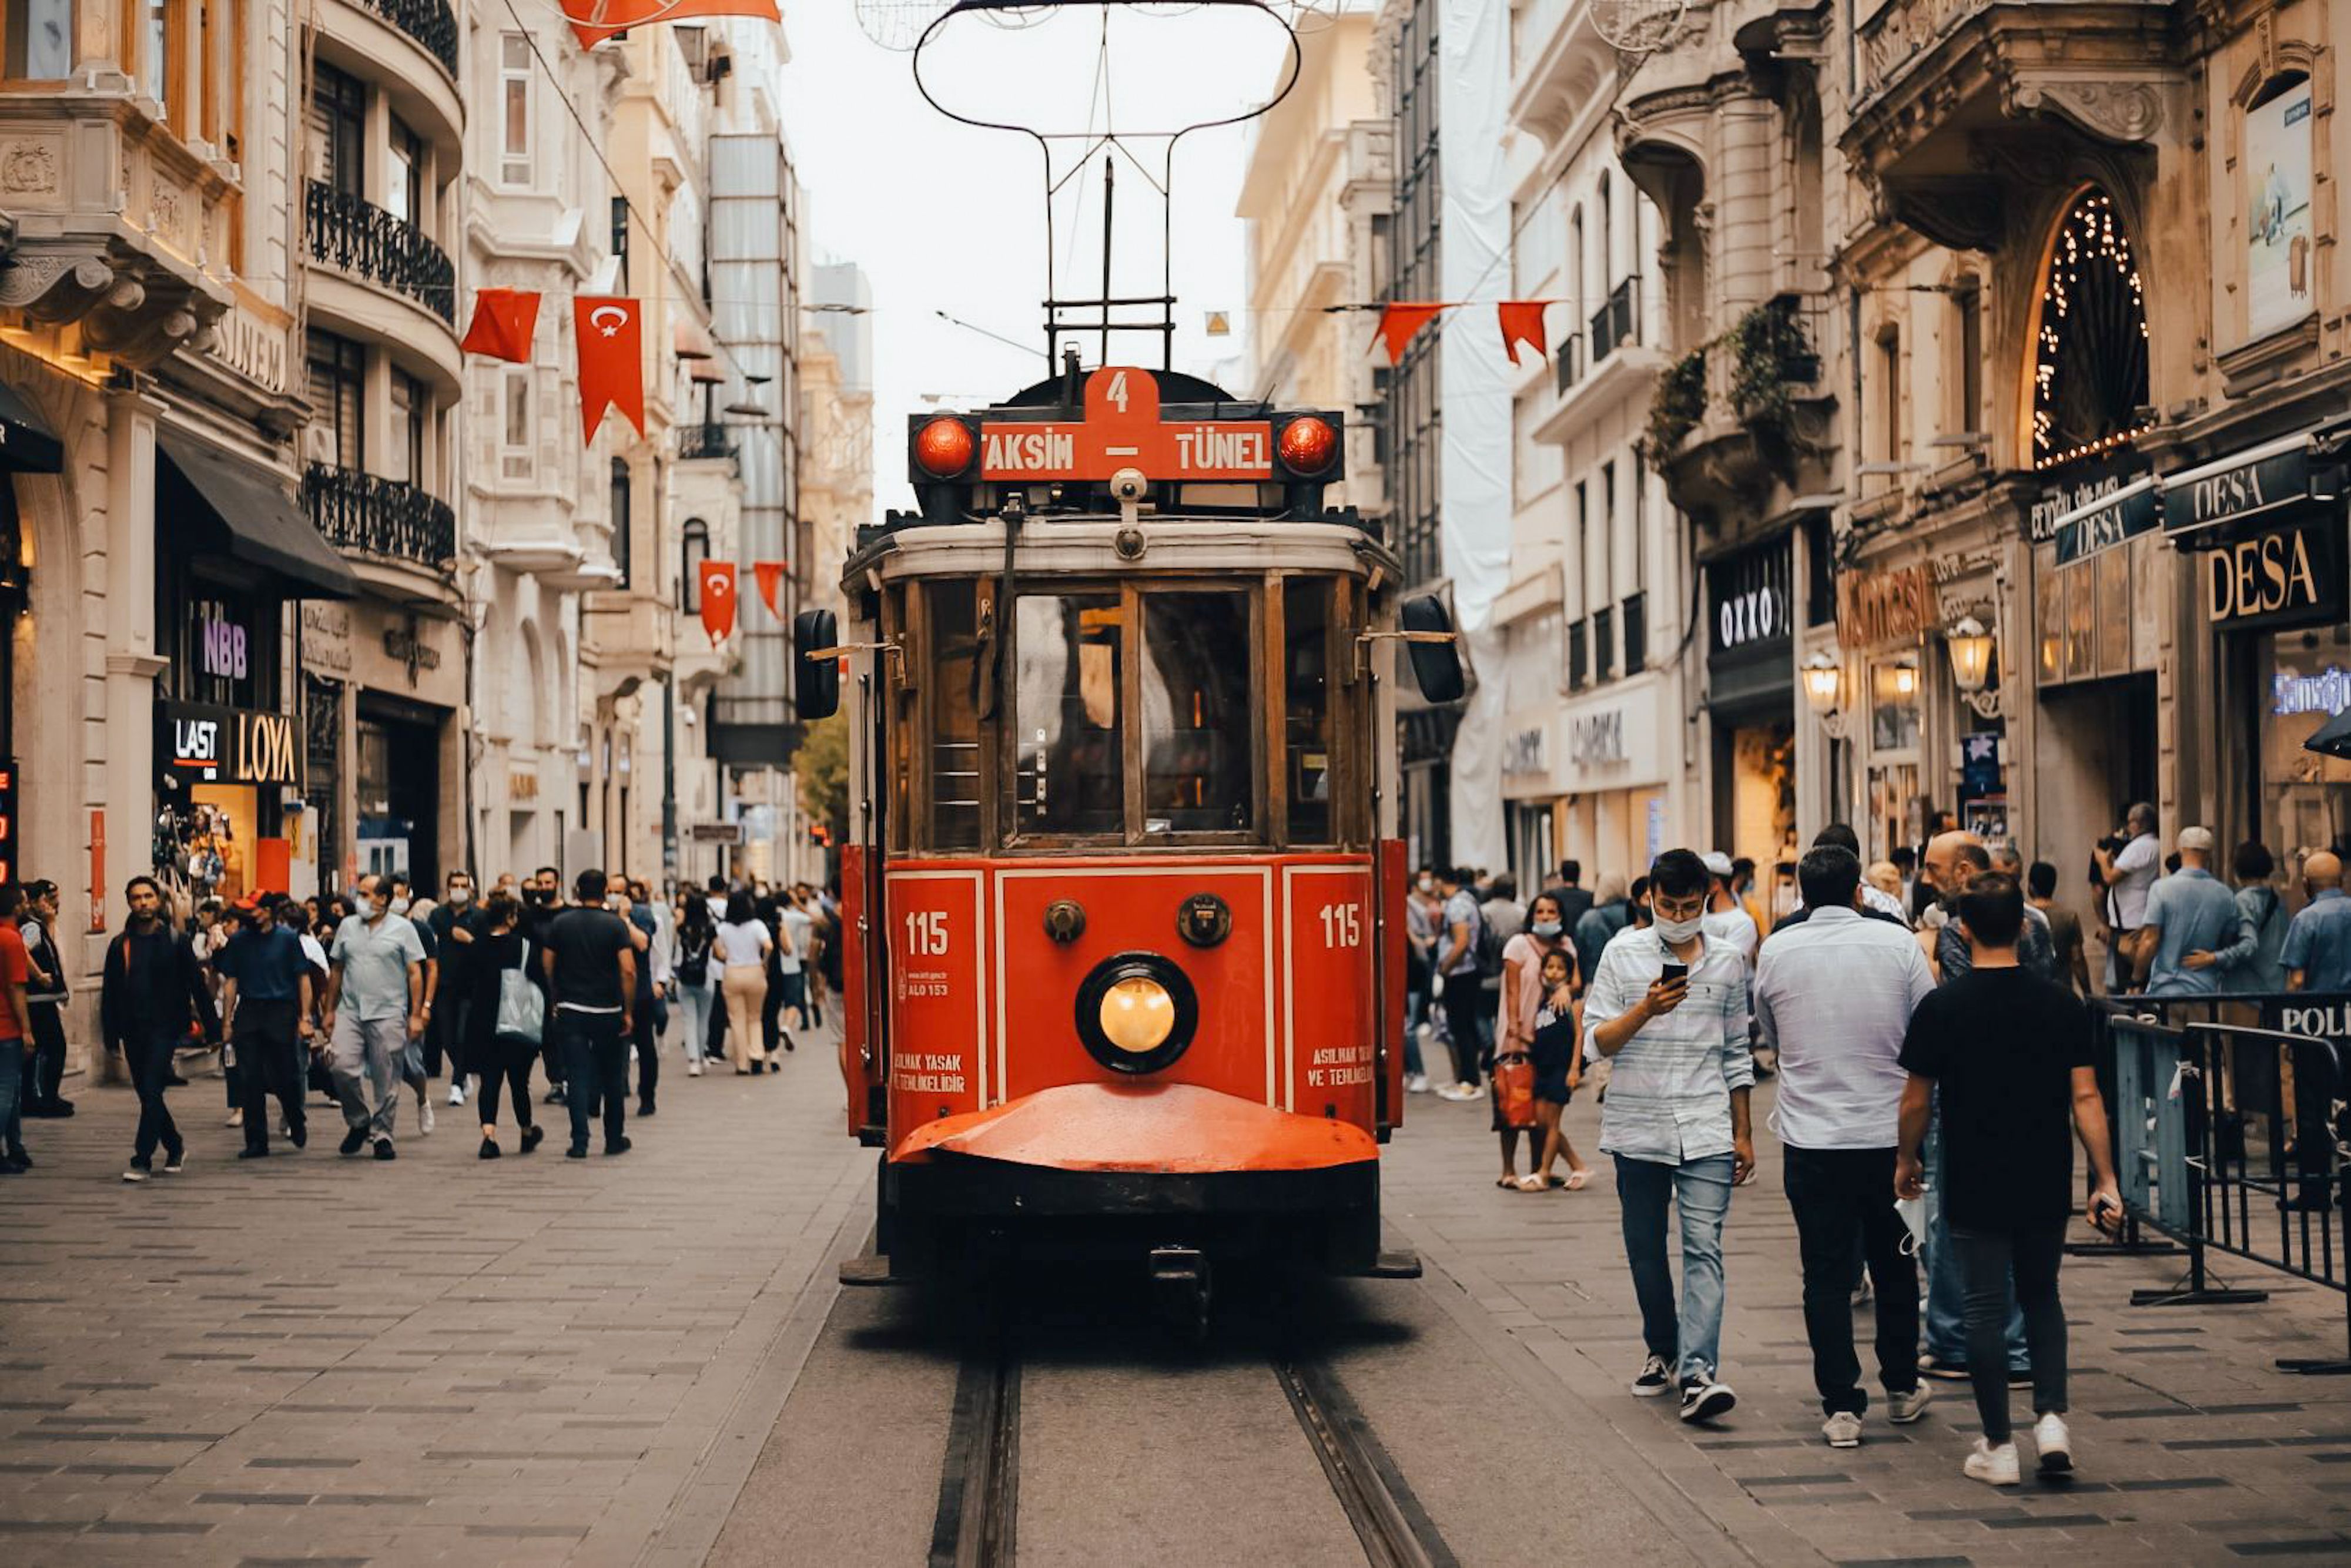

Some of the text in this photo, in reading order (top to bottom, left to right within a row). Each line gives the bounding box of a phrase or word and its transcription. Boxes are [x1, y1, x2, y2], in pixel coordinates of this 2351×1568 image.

[1107, 371, 1128, 413] 4
[981, 427, 1073, 470] AKSİM
[1176, 426, 1272, 469] TÜNEL
[2195, 464, 2263, 521] DESA
[2077, 504, 2125, 556] DESA
[2208, 529, 2317, 621] DESA
[1720, 586, 1772, 648] OXXO
[204, 617, 246, 679] NBB
[176, 718, 217, 759] LAST
[906, 912, 948, 955] 115
[1319, 903, 1359, 948] 115
[908, 984, 948, 996] ALO 153
[925, 1054, 961, 1071] YASAK
[1308, 1069, 1324, 1087] VE
